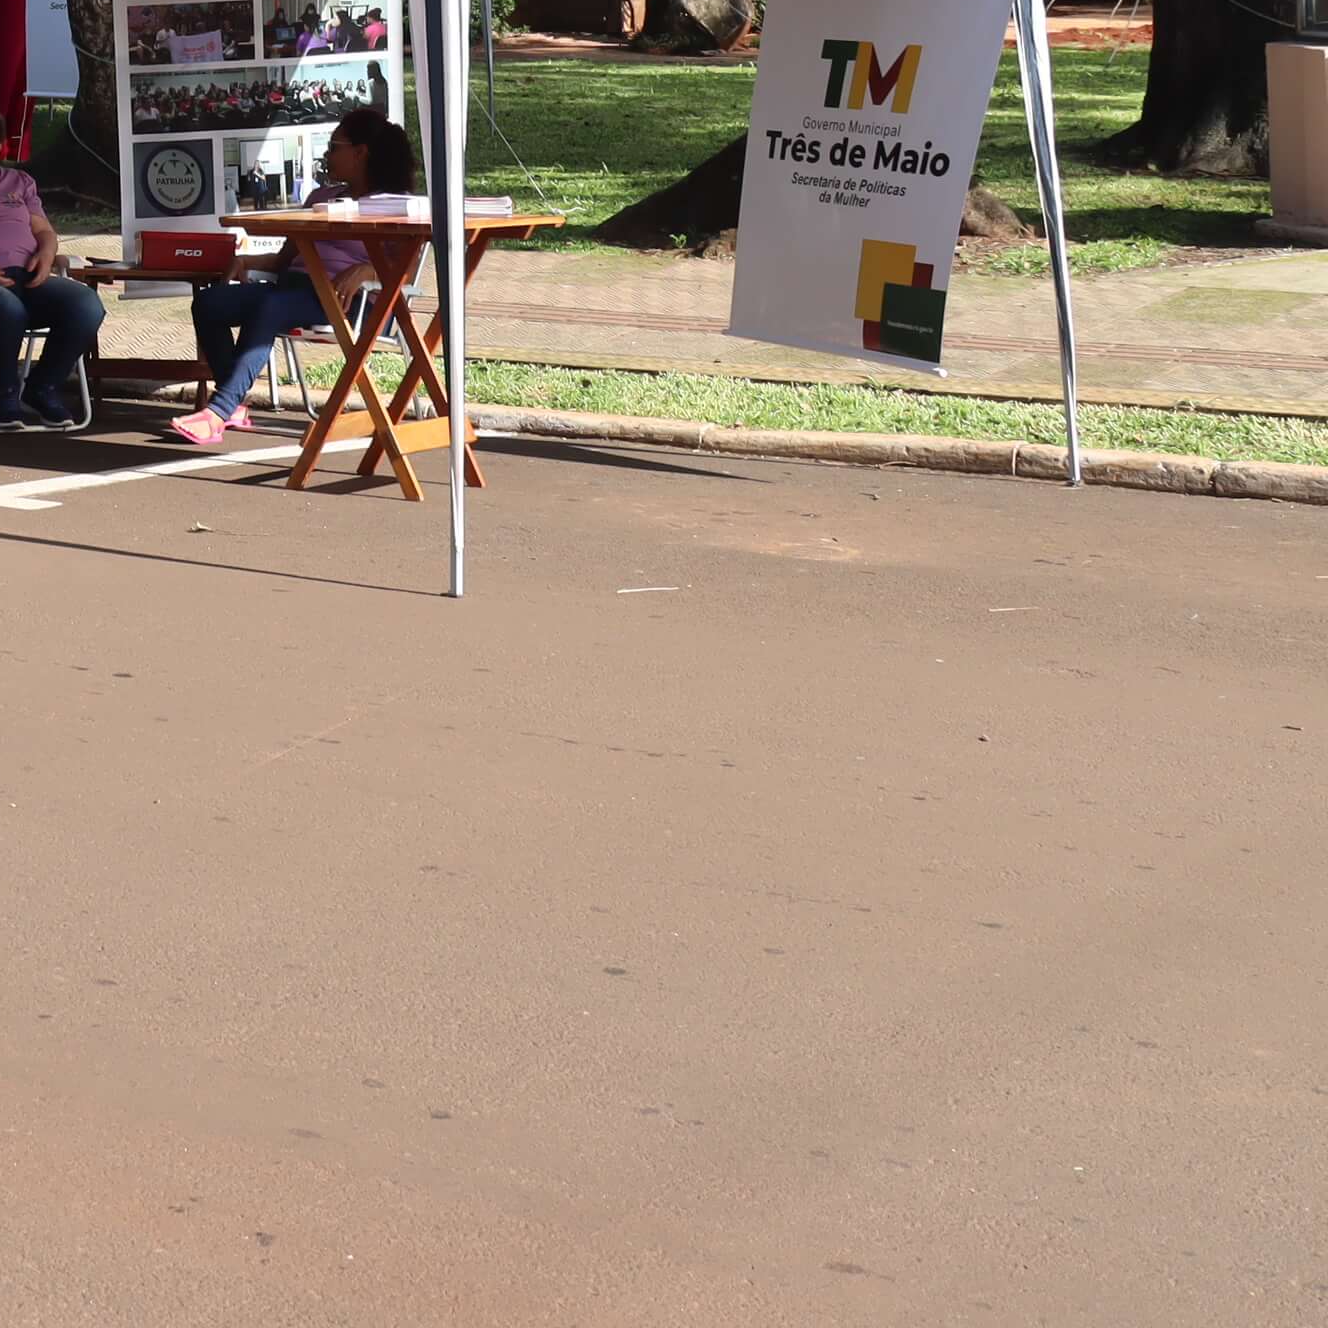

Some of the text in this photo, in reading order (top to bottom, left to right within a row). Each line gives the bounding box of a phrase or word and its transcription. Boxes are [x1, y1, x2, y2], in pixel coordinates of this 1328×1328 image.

[821, 39, 922, 114] TM
[802, 116, 901, 138] Governo Municipal
[766, 130, 950, 177] Três de Maio
[791, 172, 841, 190] Secretaria
[843, 177, 856, 191] de
[818, 191, 870, 208] da Mulher
